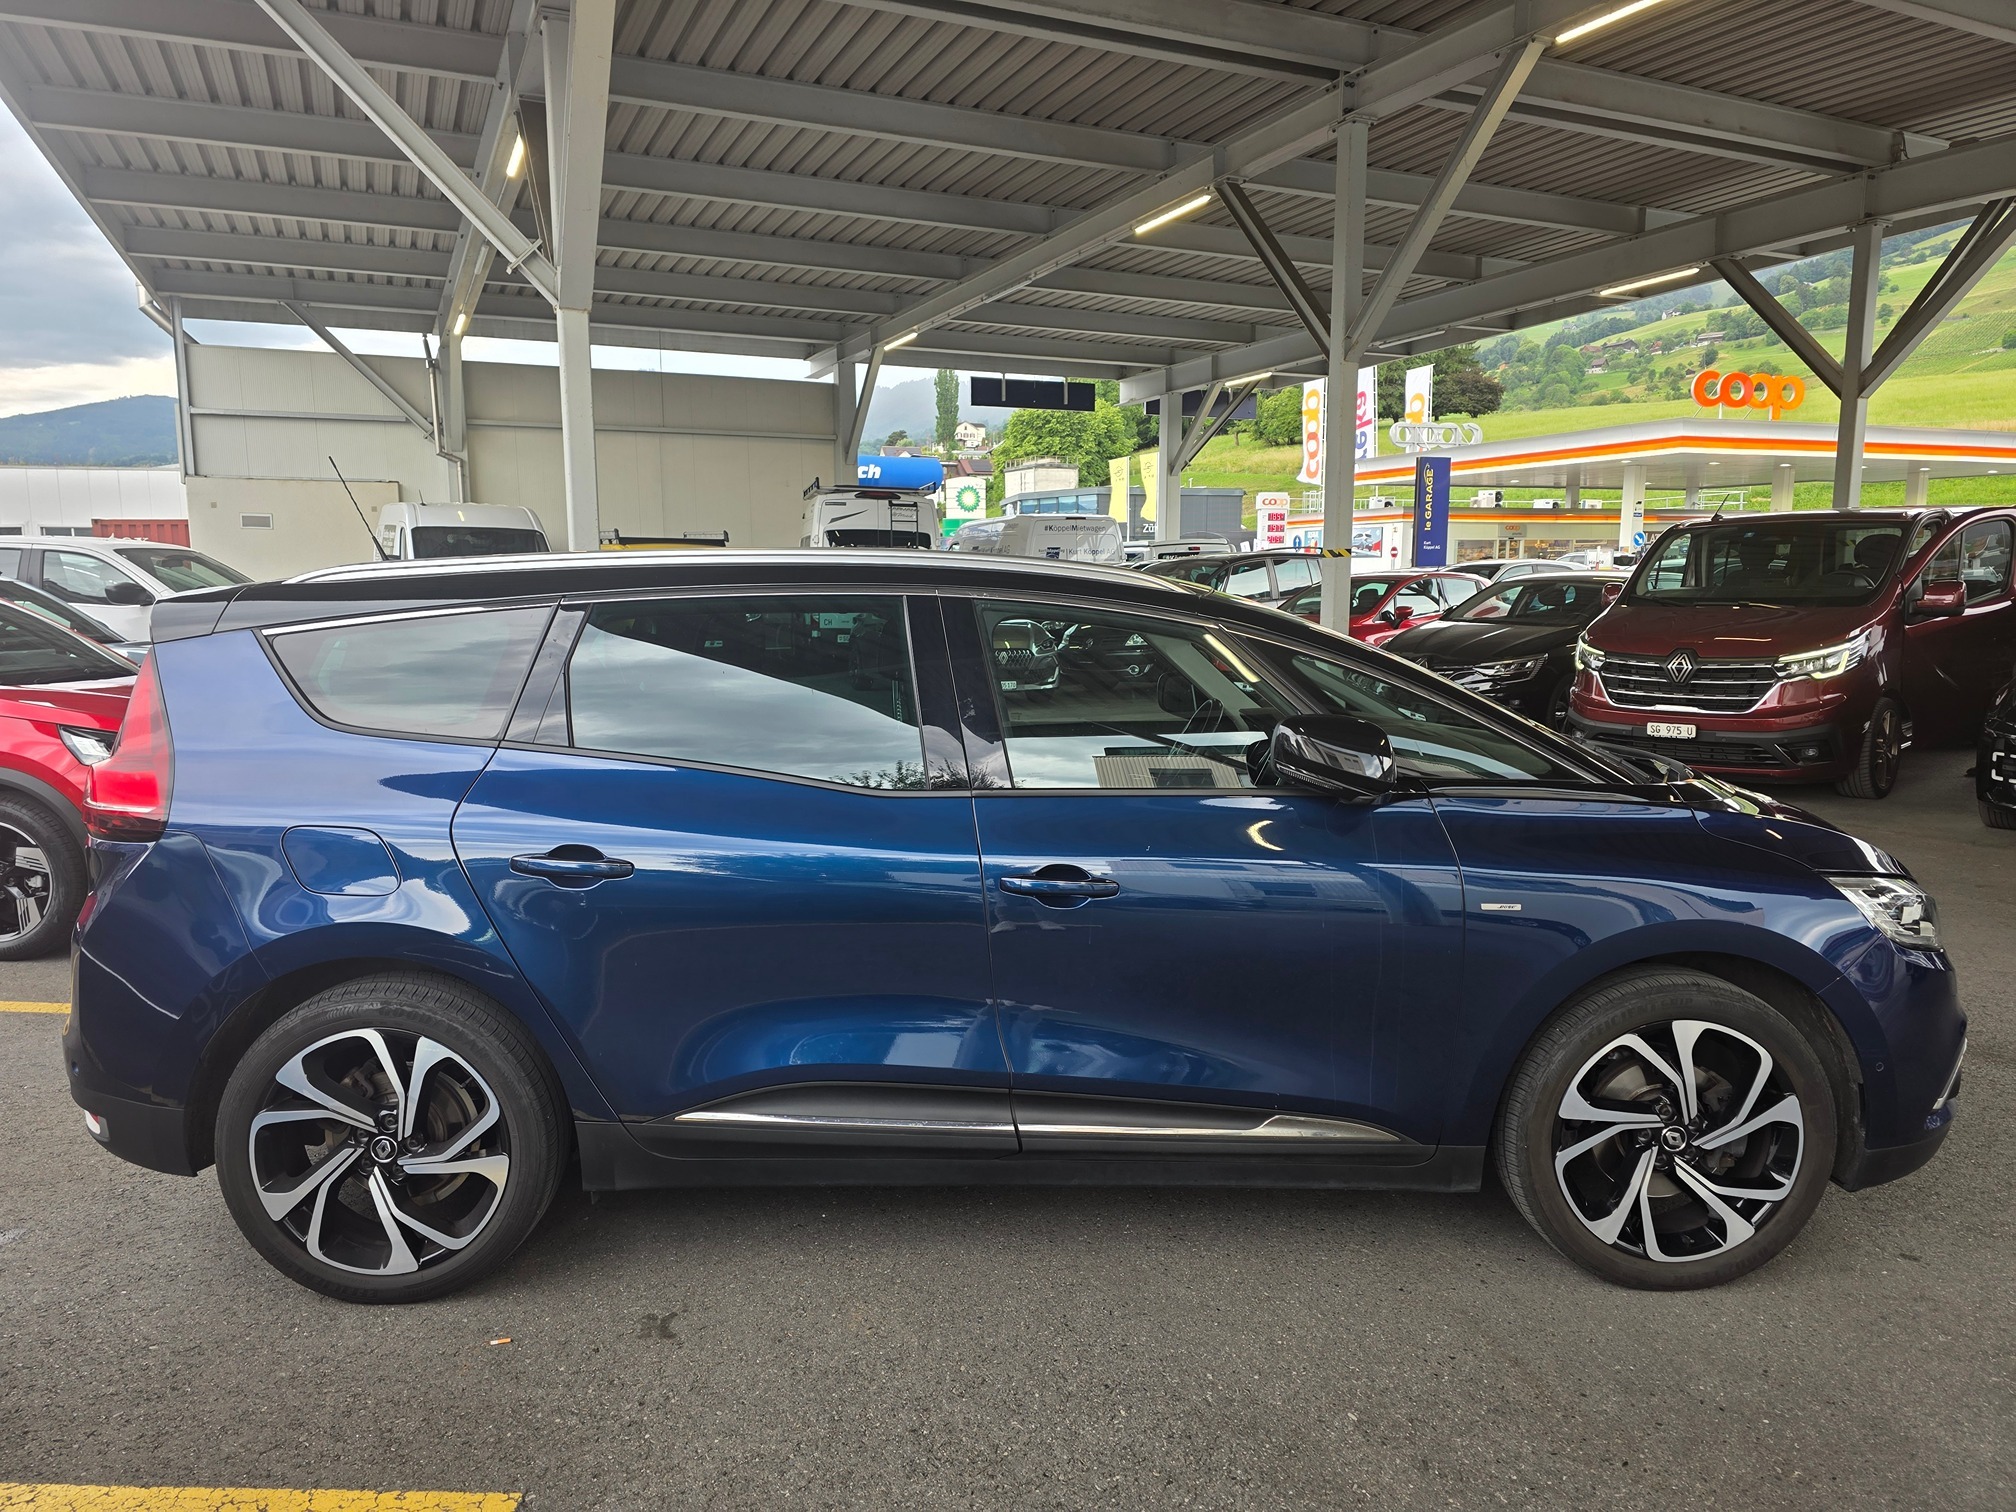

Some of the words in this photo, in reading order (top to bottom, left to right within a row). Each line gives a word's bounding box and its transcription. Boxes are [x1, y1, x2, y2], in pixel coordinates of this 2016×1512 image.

[1691, 369, 1805, 420] coop
[1424, 468, 1434, 519] GARAGE
[1262, 498, 1288, 507] coop
[1424, 521, 1431, 531] le
[1083, 548, 1105, 556] Köppel
[1650, 724, 1661, 733] SG
[1665, 725, 1682, 735] 975
[1686, 727, 1693, 735] U
